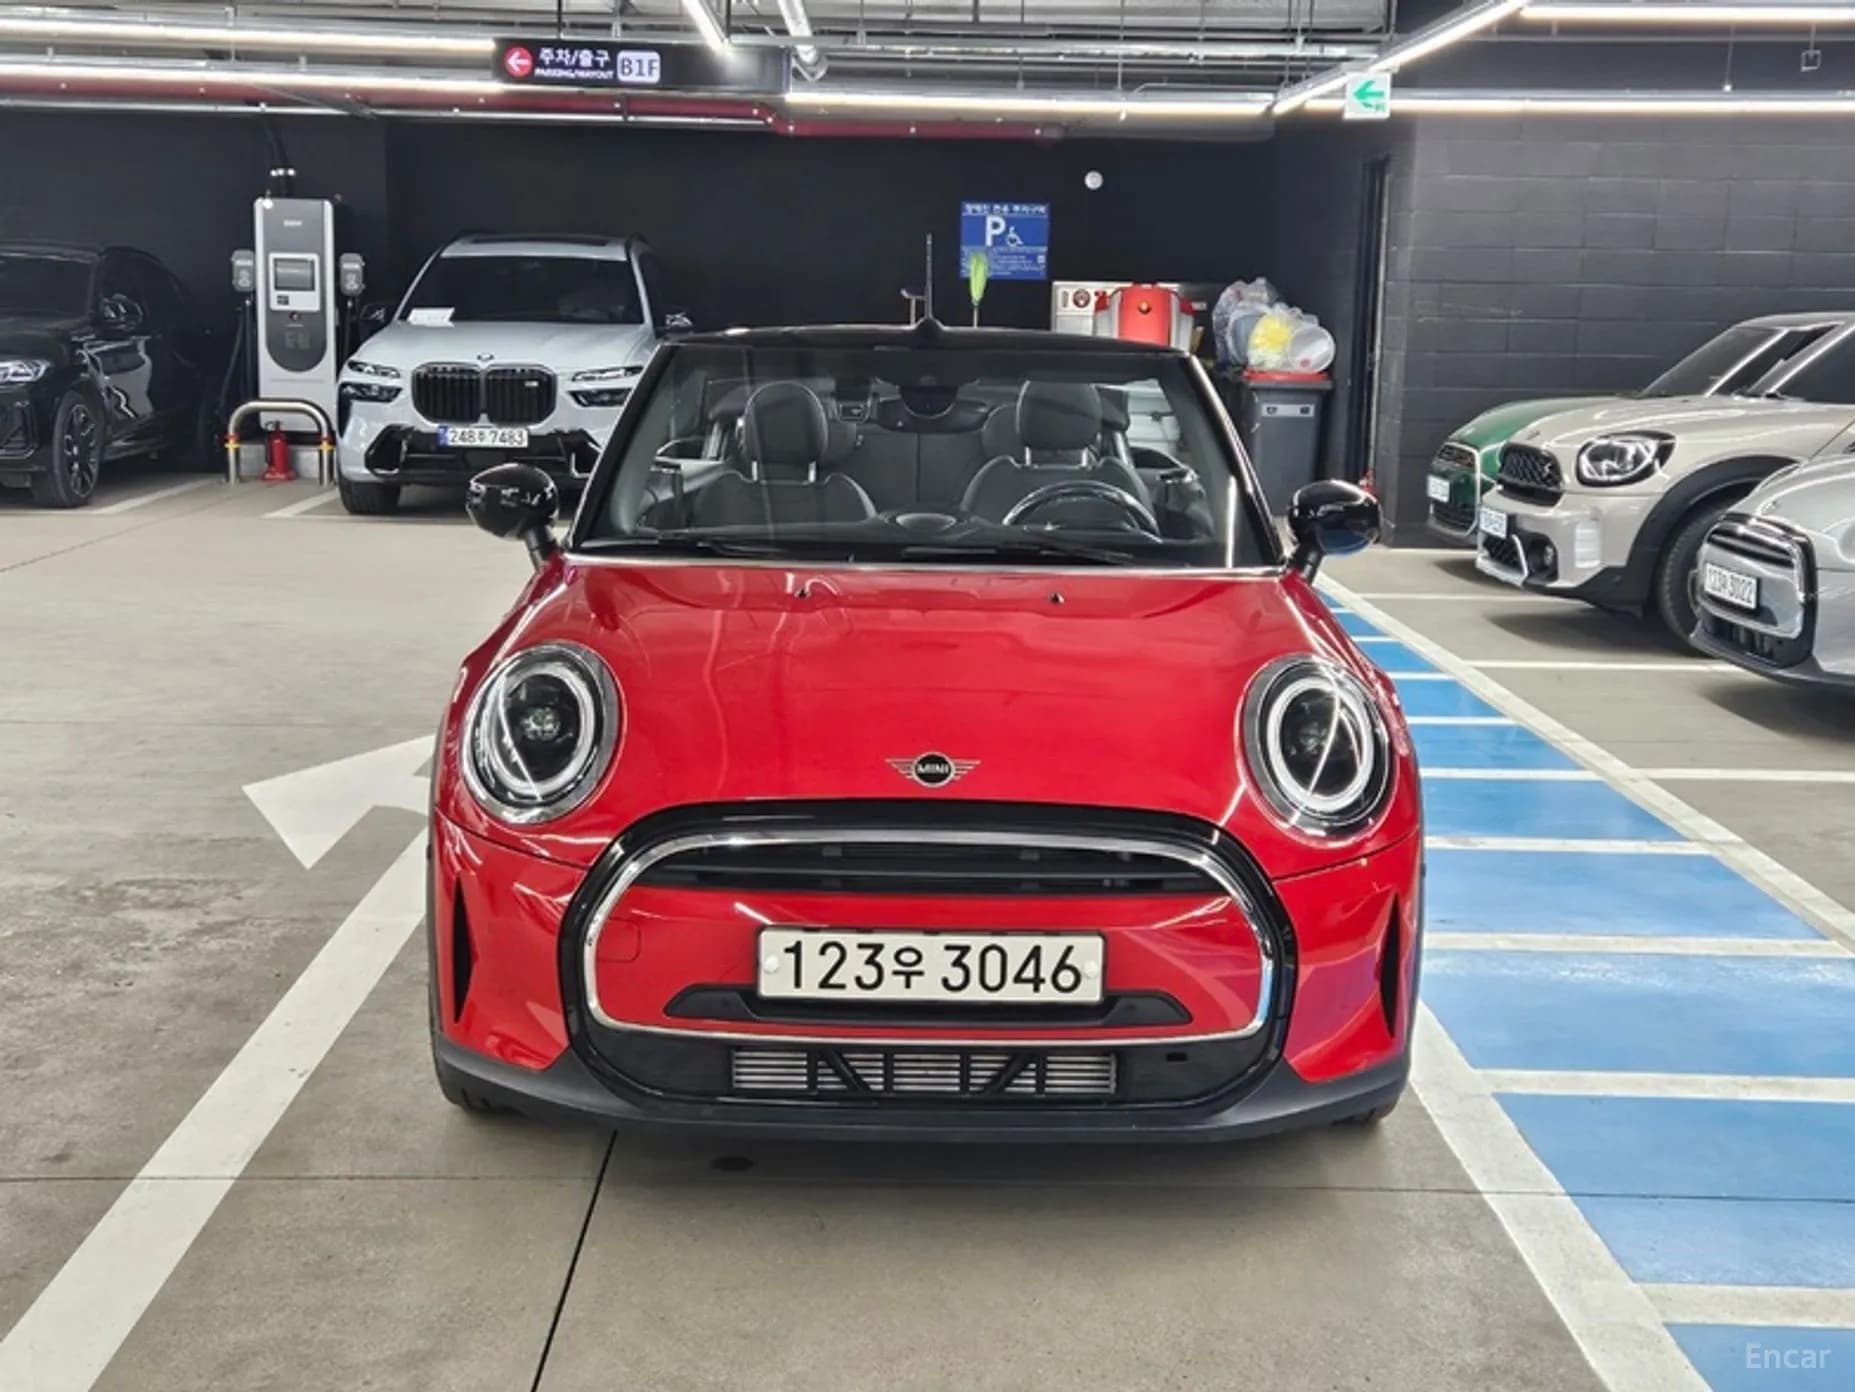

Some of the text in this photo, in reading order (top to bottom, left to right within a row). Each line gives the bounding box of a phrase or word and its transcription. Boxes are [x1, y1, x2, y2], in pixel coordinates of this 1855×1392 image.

[539, 47, 610, 67] 주차/출구
[621, 57, 659, 77] B1F
[985, 215, 1006, 247] P
[917, 763, 949, 774] MINI
[784, 940, 1083, 993] 123우 3046
